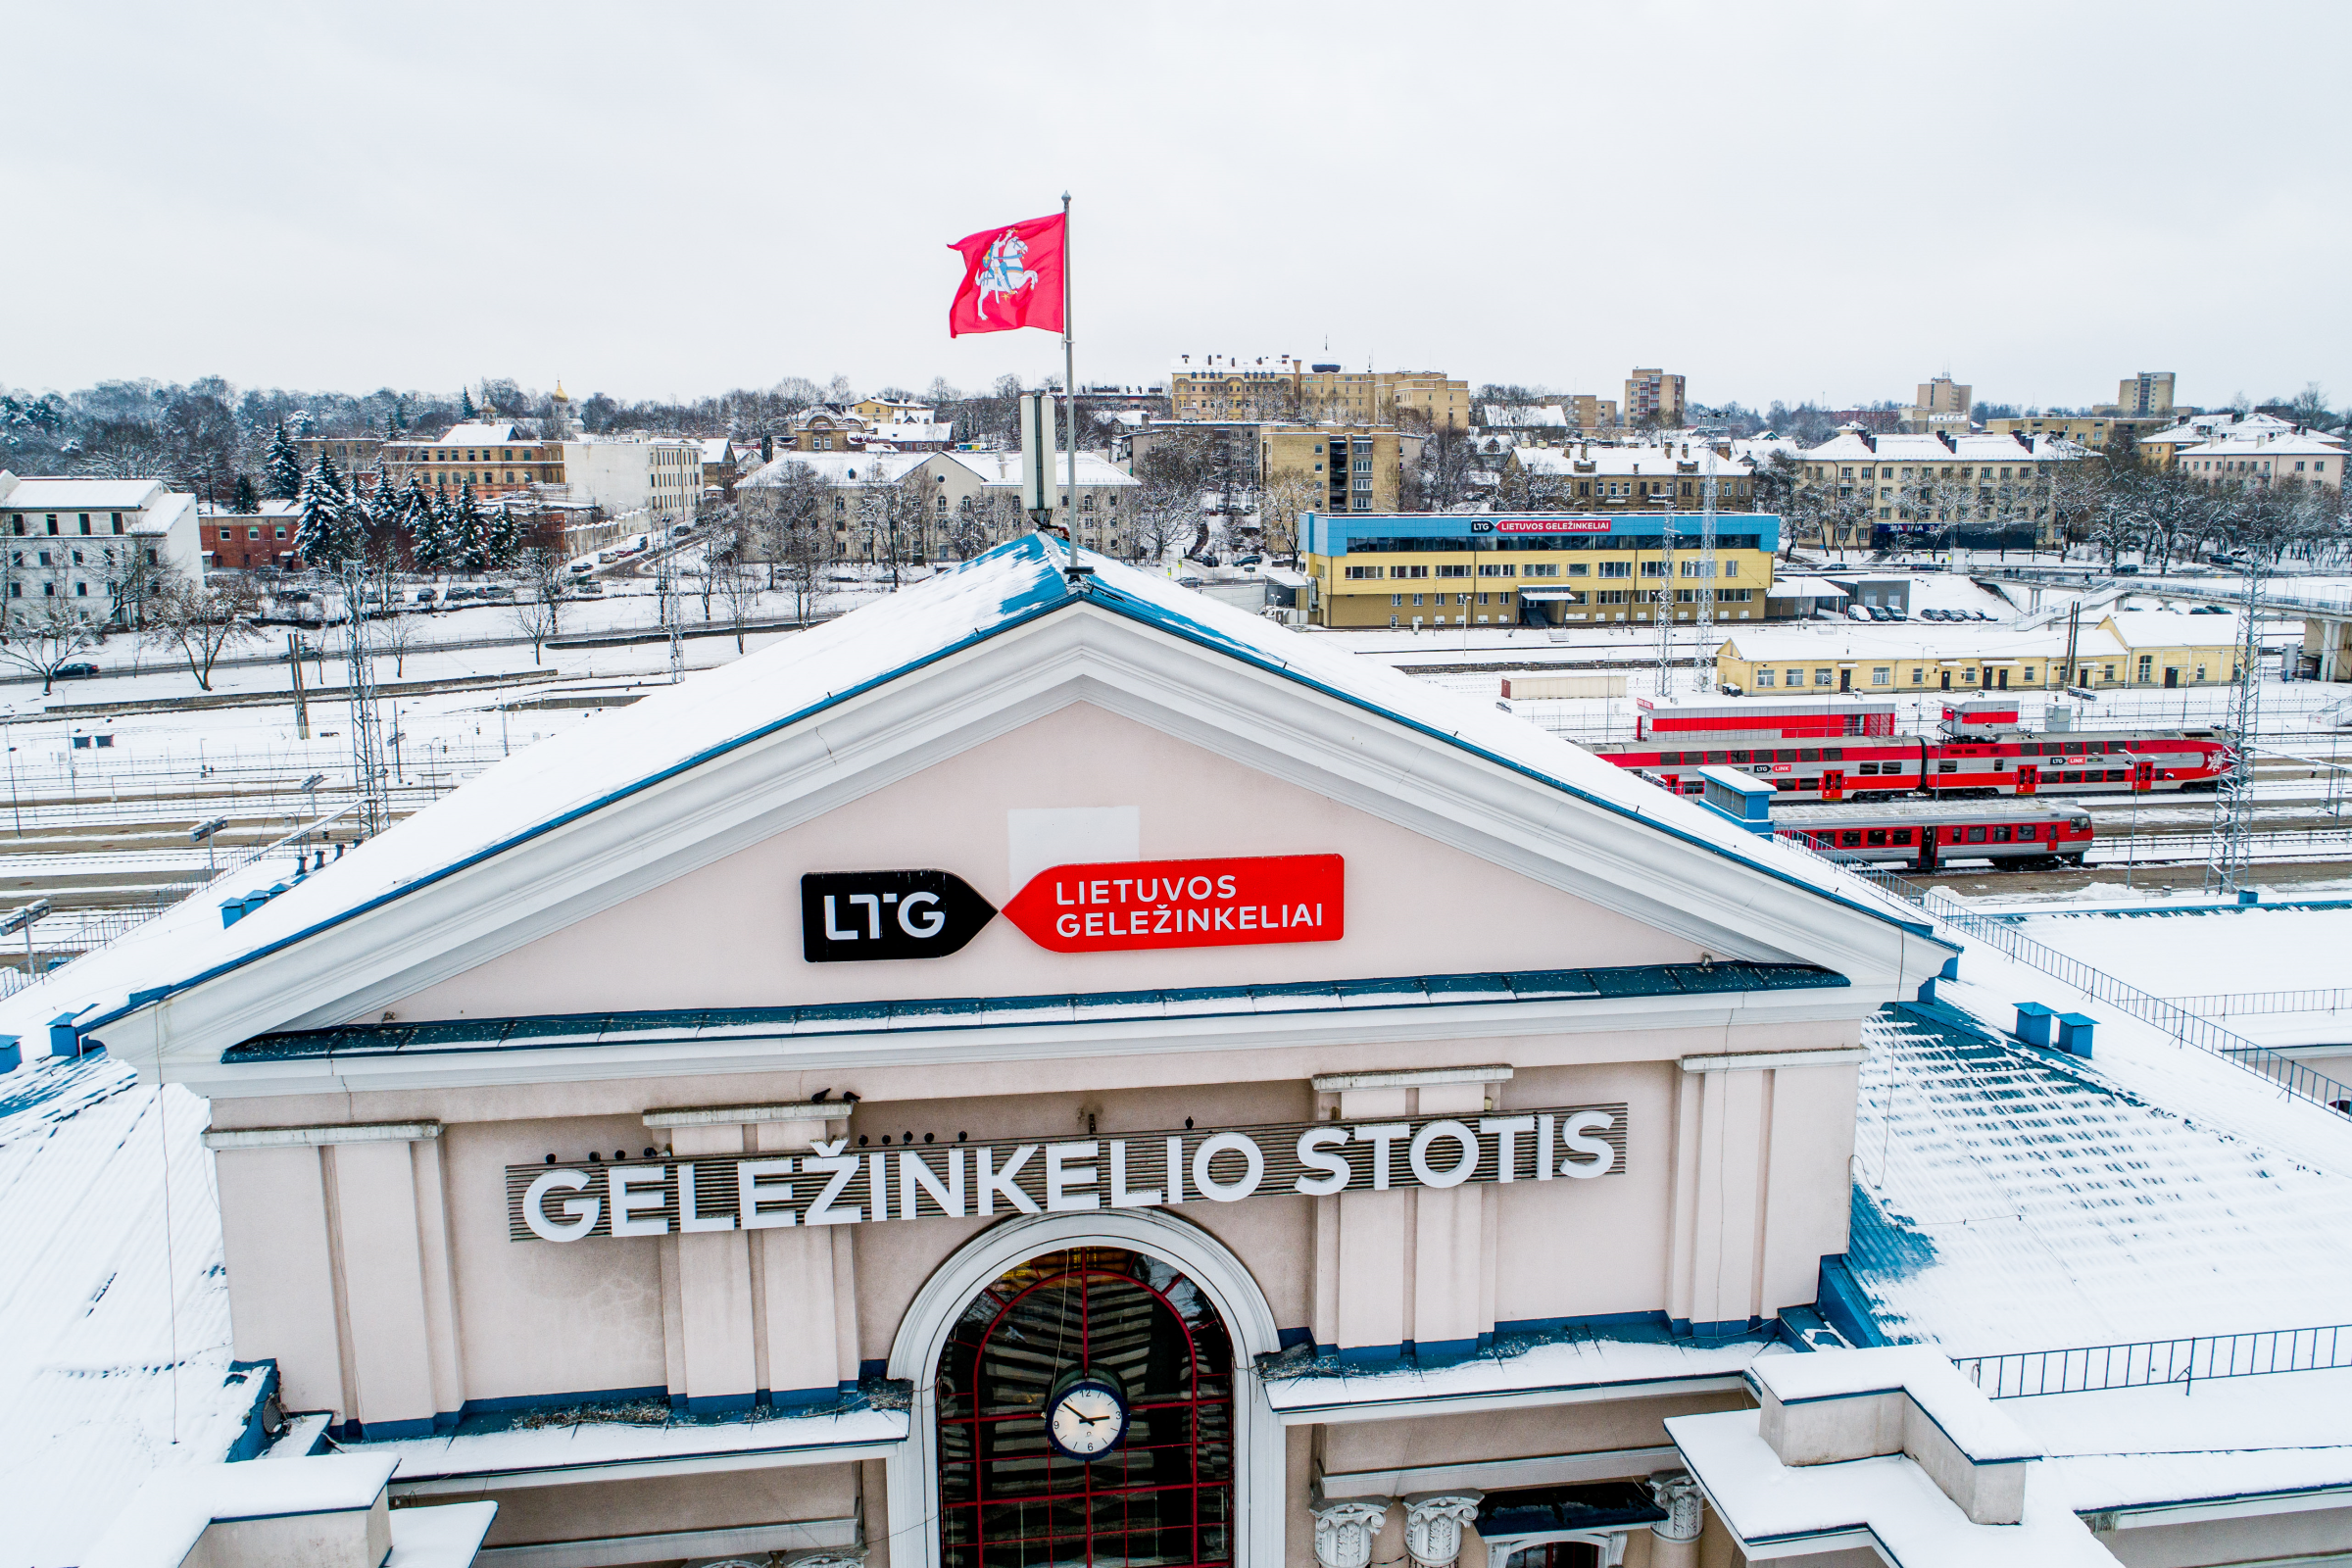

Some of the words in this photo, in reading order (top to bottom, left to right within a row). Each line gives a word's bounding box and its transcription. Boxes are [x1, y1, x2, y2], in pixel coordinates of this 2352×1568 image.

[1545, 520, 1609, 530] GELEŽINKELIAI
[1055, 874, 1238, 906] LIETUVOS
[824, 891, 946, 941] LTG
[1055, 903, 1323, 938] GELEŽINKELIAI
[522, 1131, 1264, 1243] GELEŽINKELIO
[1294, 1110, 1615, 1197] STOTIS
[1054, 1420, 1060, 1430] 9
[1115, 1410, 1122, 1420] 3
[1087, 1442, 1094, 1451] 6
